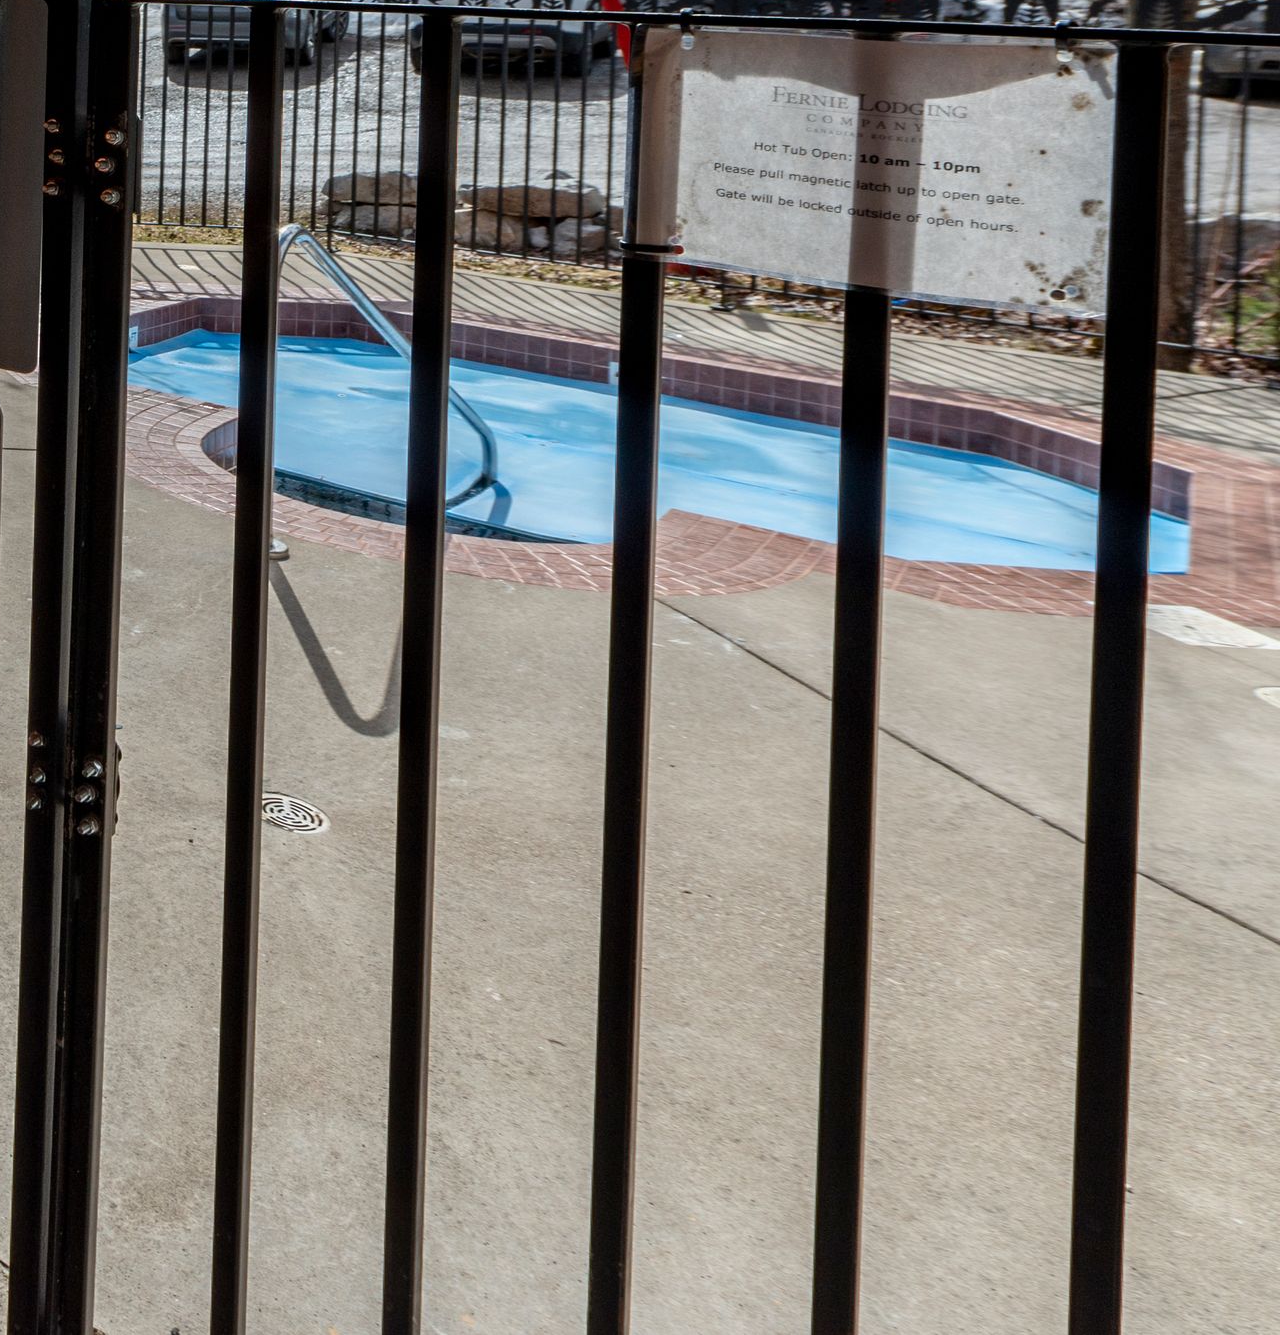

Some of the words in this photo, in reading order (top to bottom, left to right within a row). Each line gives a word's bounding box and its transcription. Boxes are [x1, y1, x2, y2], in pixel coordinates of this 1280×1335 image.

[772, 86, 849, 109] FERNIE
[858, 93, 969, 119] LODGING
[806, 113, 925, 132] COMPANY
[754, 142, 778, 153] Hot
[782, 144, 807, 156] Tub
[812, 148, 853, 162] Open:
[859, 153, 880, 165] 10
[884, 158, 910, 167] am
[933, 161, 981, 174] 10pm
[713, 162, 755, 176] Please
[759, 168, 784, 179] pull
[788, 173, 852, 189] magnetic
[856, 179, 892, 193] latch
[897, 185, 916, 197] up
[921, 187, 937, 198] to
[942, 190, 980, 202] open
[986, 192, 1025, 206] gate.
[715, 188, 747, 201] Gate
[751, 193, 773, 204] will
[778, 196, 795, 207] be
[799, 199, 843, 214] locked
[847, 207, 901, 222] outside
[906, 213, 922, 223] of
[926, 215, 964, 228] open
[970, 218, 1019, 233] hours.
